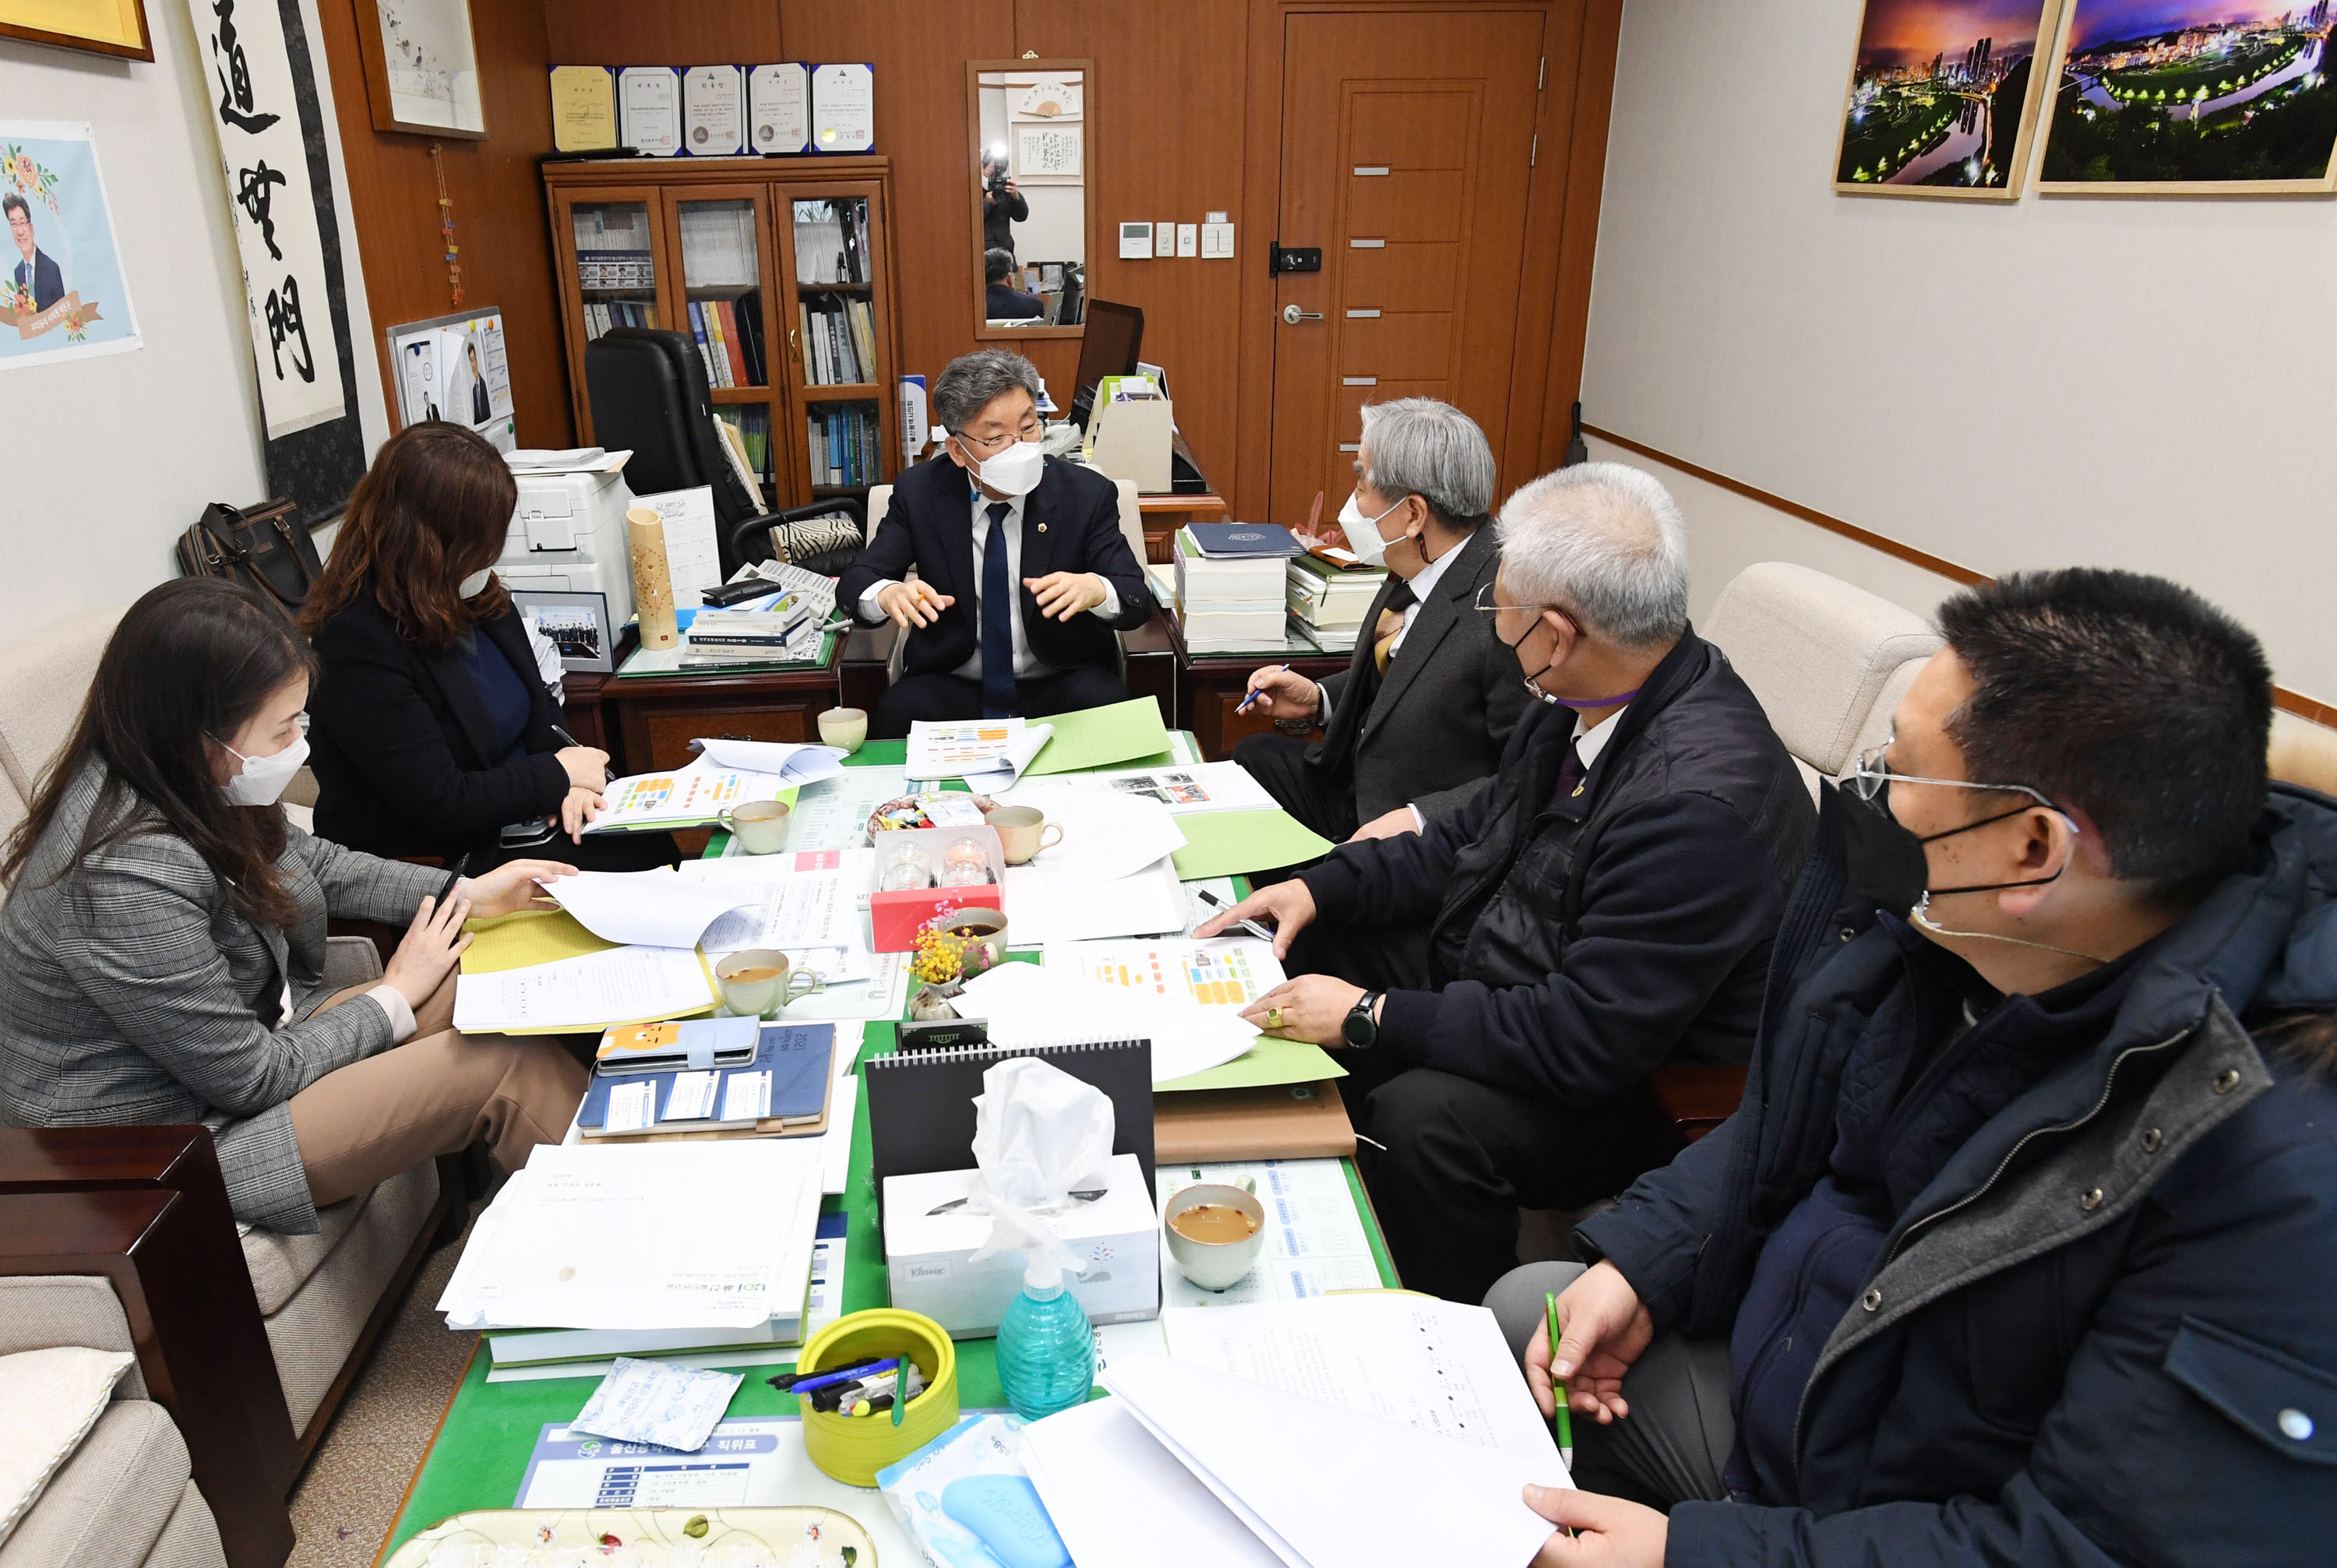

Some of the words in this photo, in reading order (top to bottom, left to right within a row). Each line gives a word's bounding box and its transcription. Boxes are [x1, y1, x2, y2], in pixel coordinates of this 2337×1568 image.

[30, 318, 48, 332] 우리동네
[794, 1034, 807, 1051] 2021
[911, 1267, 946, 1277] Kleenex
[717, 1439, 756, 1450] 직위표
